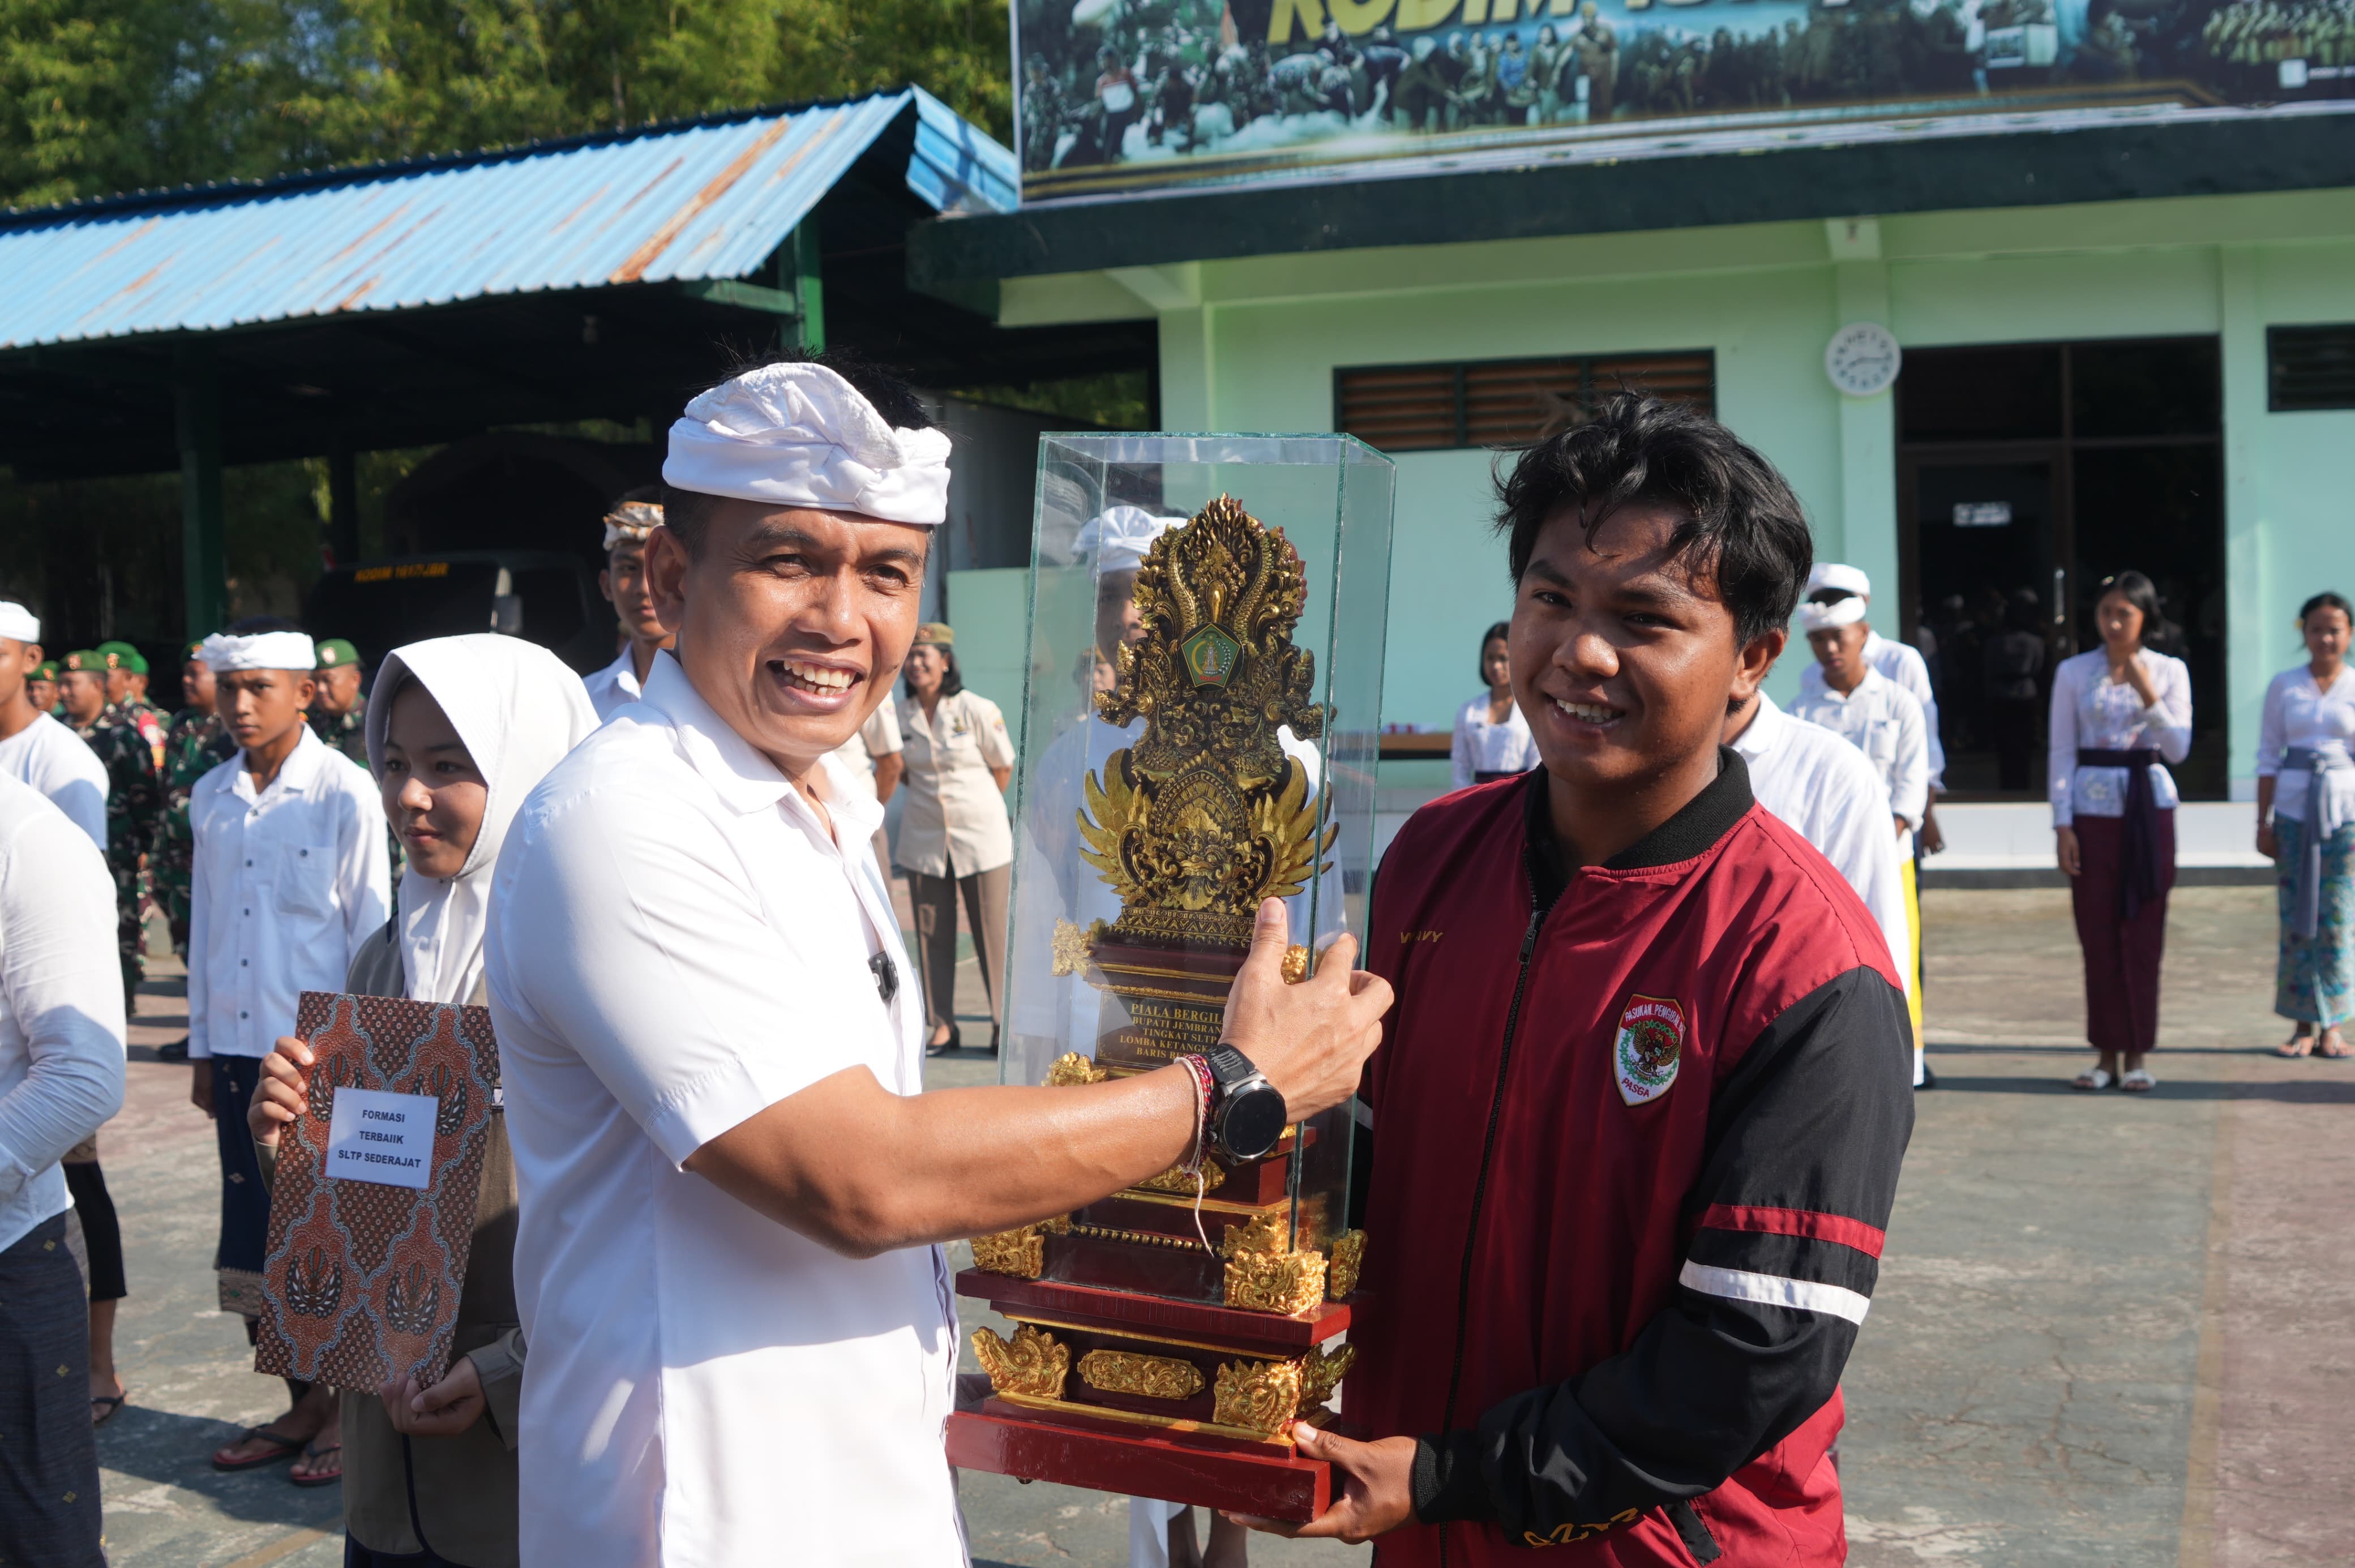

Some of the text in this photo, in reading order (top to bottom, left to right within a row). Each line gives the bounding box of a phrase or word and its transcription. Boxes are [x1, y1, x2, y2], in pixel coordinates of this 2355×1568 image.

[1131, 1003, 1169, 1017] PIALA
[1625, 1004, 1652, 1022] PASUKAN
[1132, 1017, 1170, 1028] BUPATI
[1120, 1035, 1157, 1047] LOMBA
[1142, 1028, 1217, 1044] TINGKAT SLTP
[1137, 1048, 1167, 1059] BARIS
[1621, 1078, 1650, 1097] PASGA
[362, 1109, 405, 1123] FORMASI
[359, 1131, 404, 1144] TERBAIIK
[338, 1150, 421, 1168] SLTP SEDERAJAT
